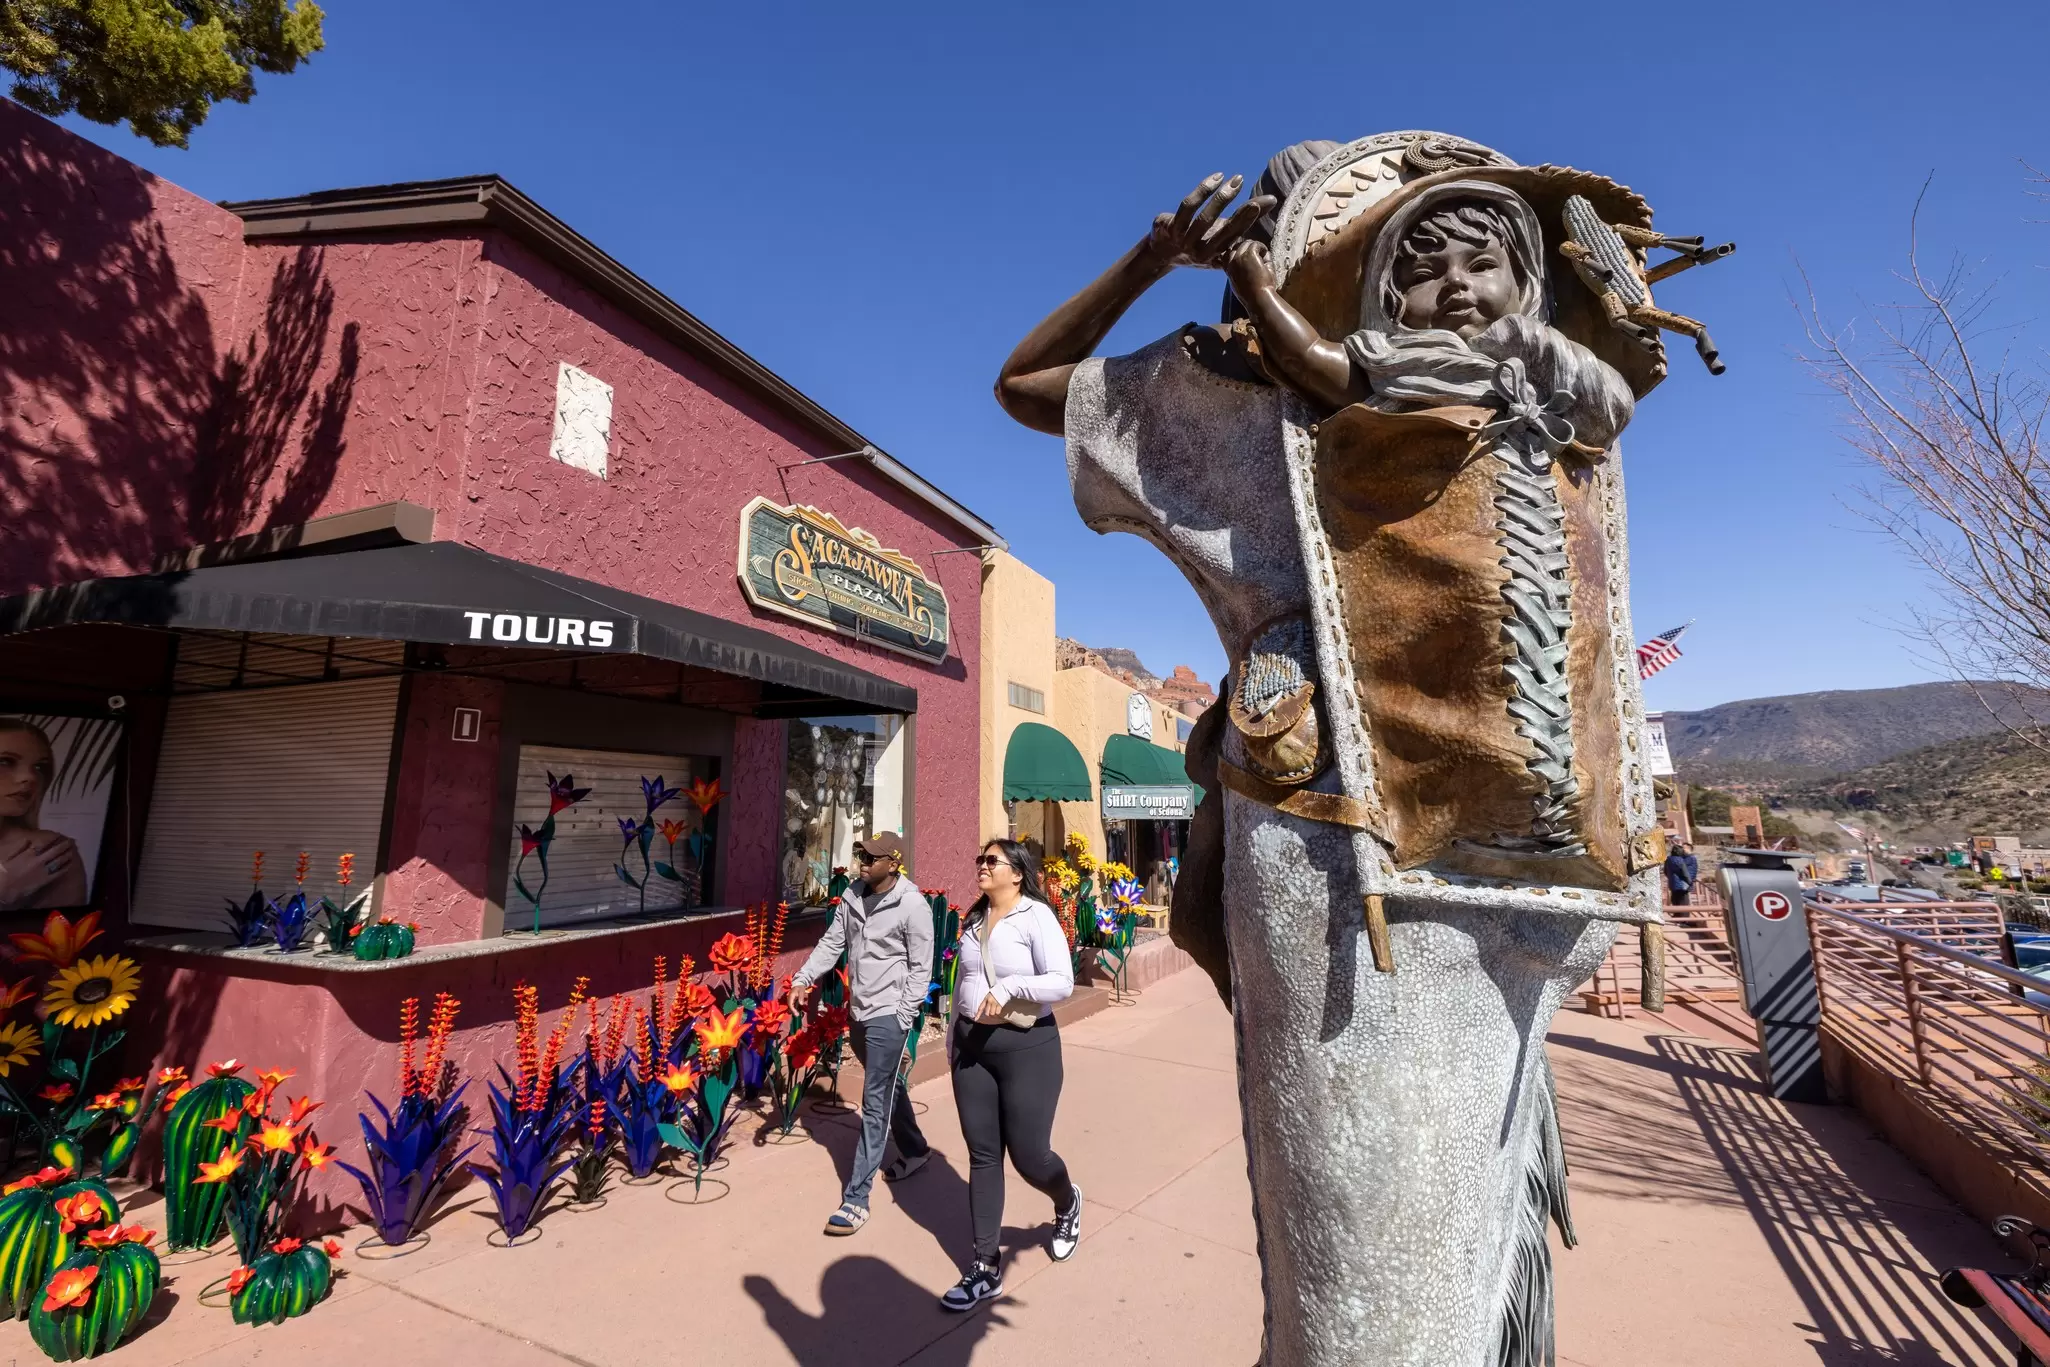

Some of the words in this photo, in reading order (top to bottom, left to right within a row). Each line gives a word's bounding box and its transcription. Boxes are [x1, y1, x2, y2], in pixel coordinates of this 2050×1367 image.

[772, 523, 933, 646] SACAJAWEA
[788, 574, 814, 590] SHOPS
[834, 574, 883, 606] PLAZA
[464, 611, 613, 647] TOURS
[1107, 795, 1137, 808] SHIRT
[1140, 795, 1188, 810] Company
[1149, 808, 1157, 816] of
[1158, 808, 1183, 816] Sedona
[1762, 896, 1785, 915] P
